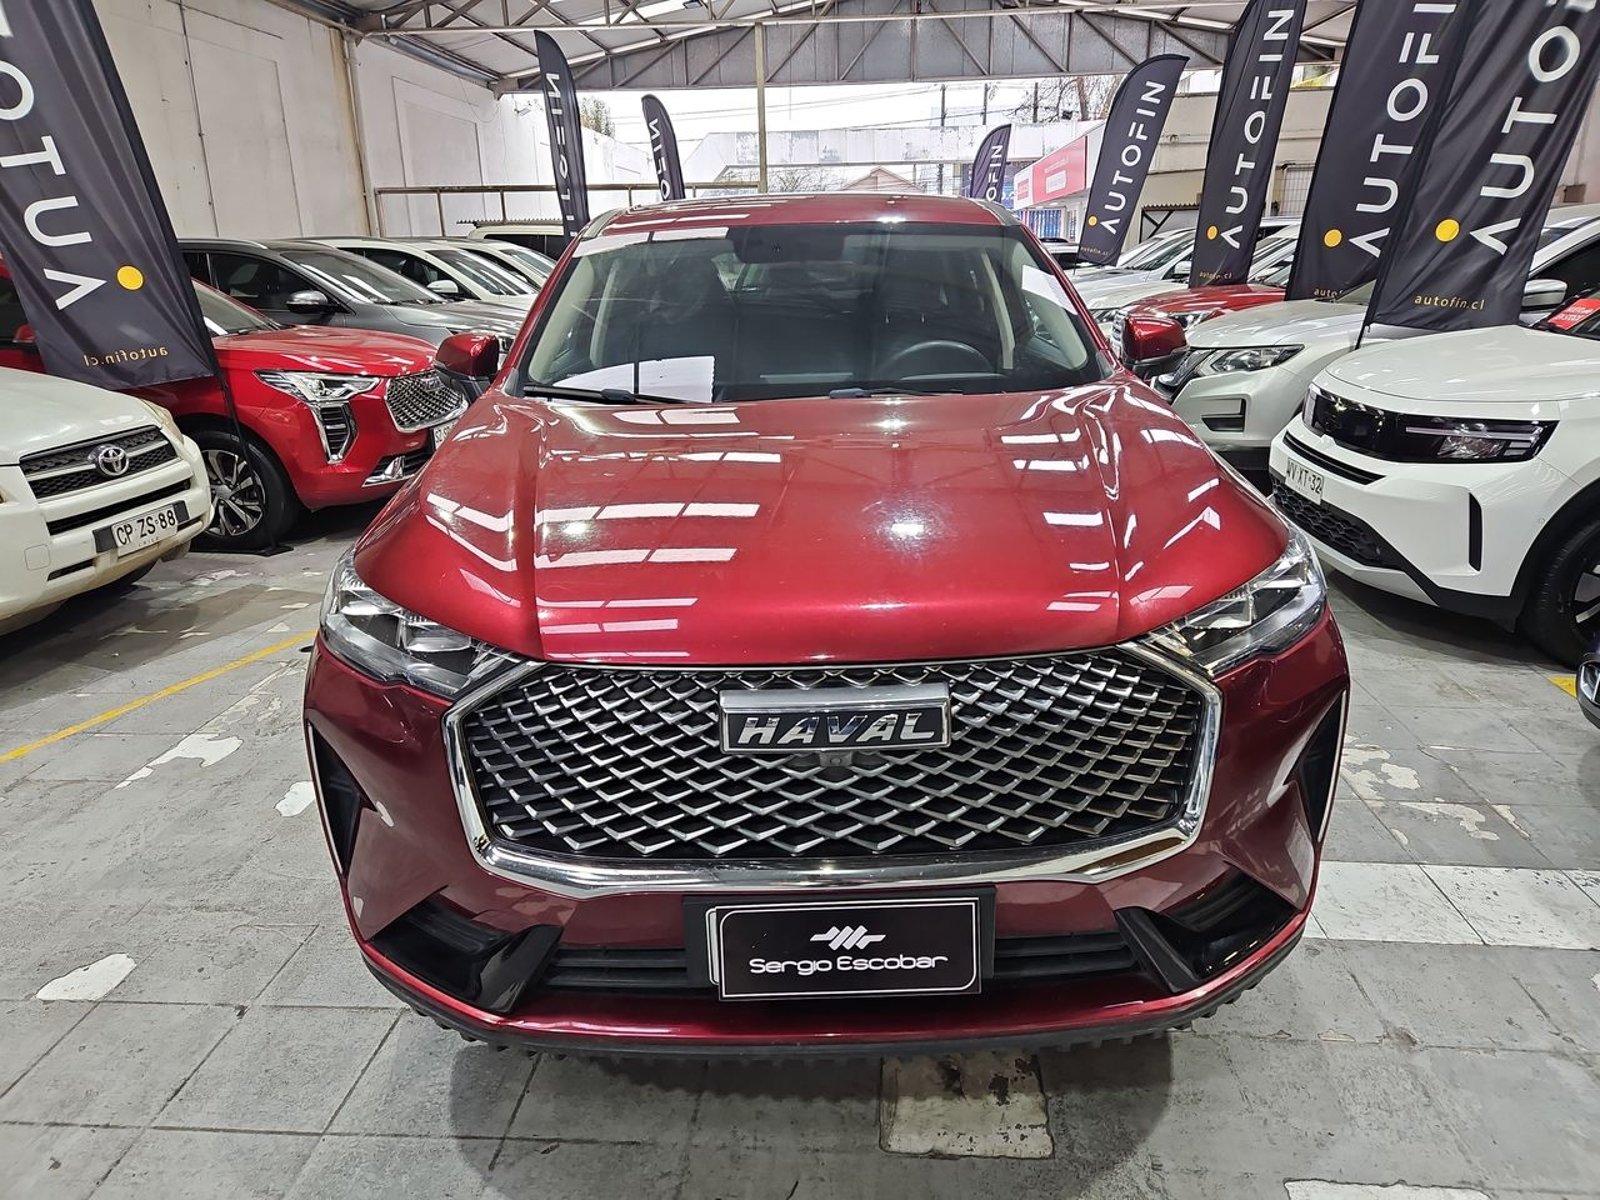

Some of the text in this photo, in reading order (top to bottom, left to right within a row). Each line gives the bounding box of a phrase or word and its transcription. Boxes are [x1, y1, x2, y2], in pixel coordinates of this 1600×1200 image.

[1101, 81, 1166, 235] AUTOFIN
[1219, 9, 1294, 249] AUTOFIN
[1469, 0, 1596, 256] AUTO
[1414, 295, 1485, 310] autofin.cl
[737, 712, 936, 744] HAVAL
[749, 954, 948, 976] Sergio Escobar
